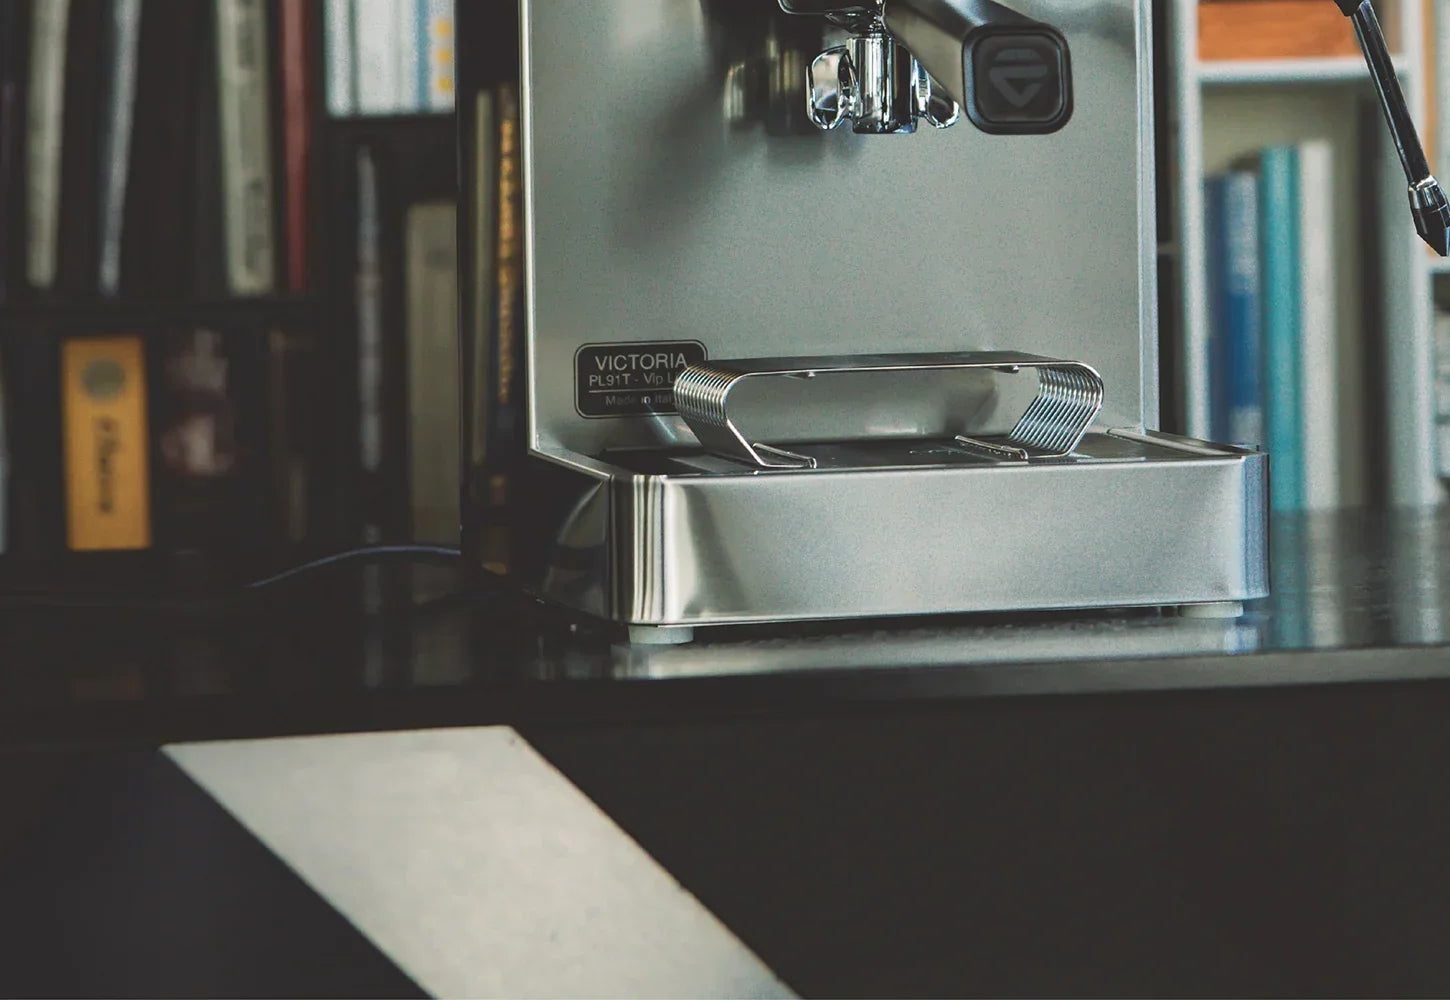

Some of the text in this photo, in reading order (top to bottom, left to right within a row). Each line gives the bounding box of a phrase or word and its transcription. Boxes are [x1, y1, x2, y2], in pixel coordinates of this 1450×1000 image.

[594, 352, 689, 371] VICTORIA
[588, 373, 631, 387] PL91T
[642, 372, 665, 387] Vip
[640, 395, 652, 405] in
